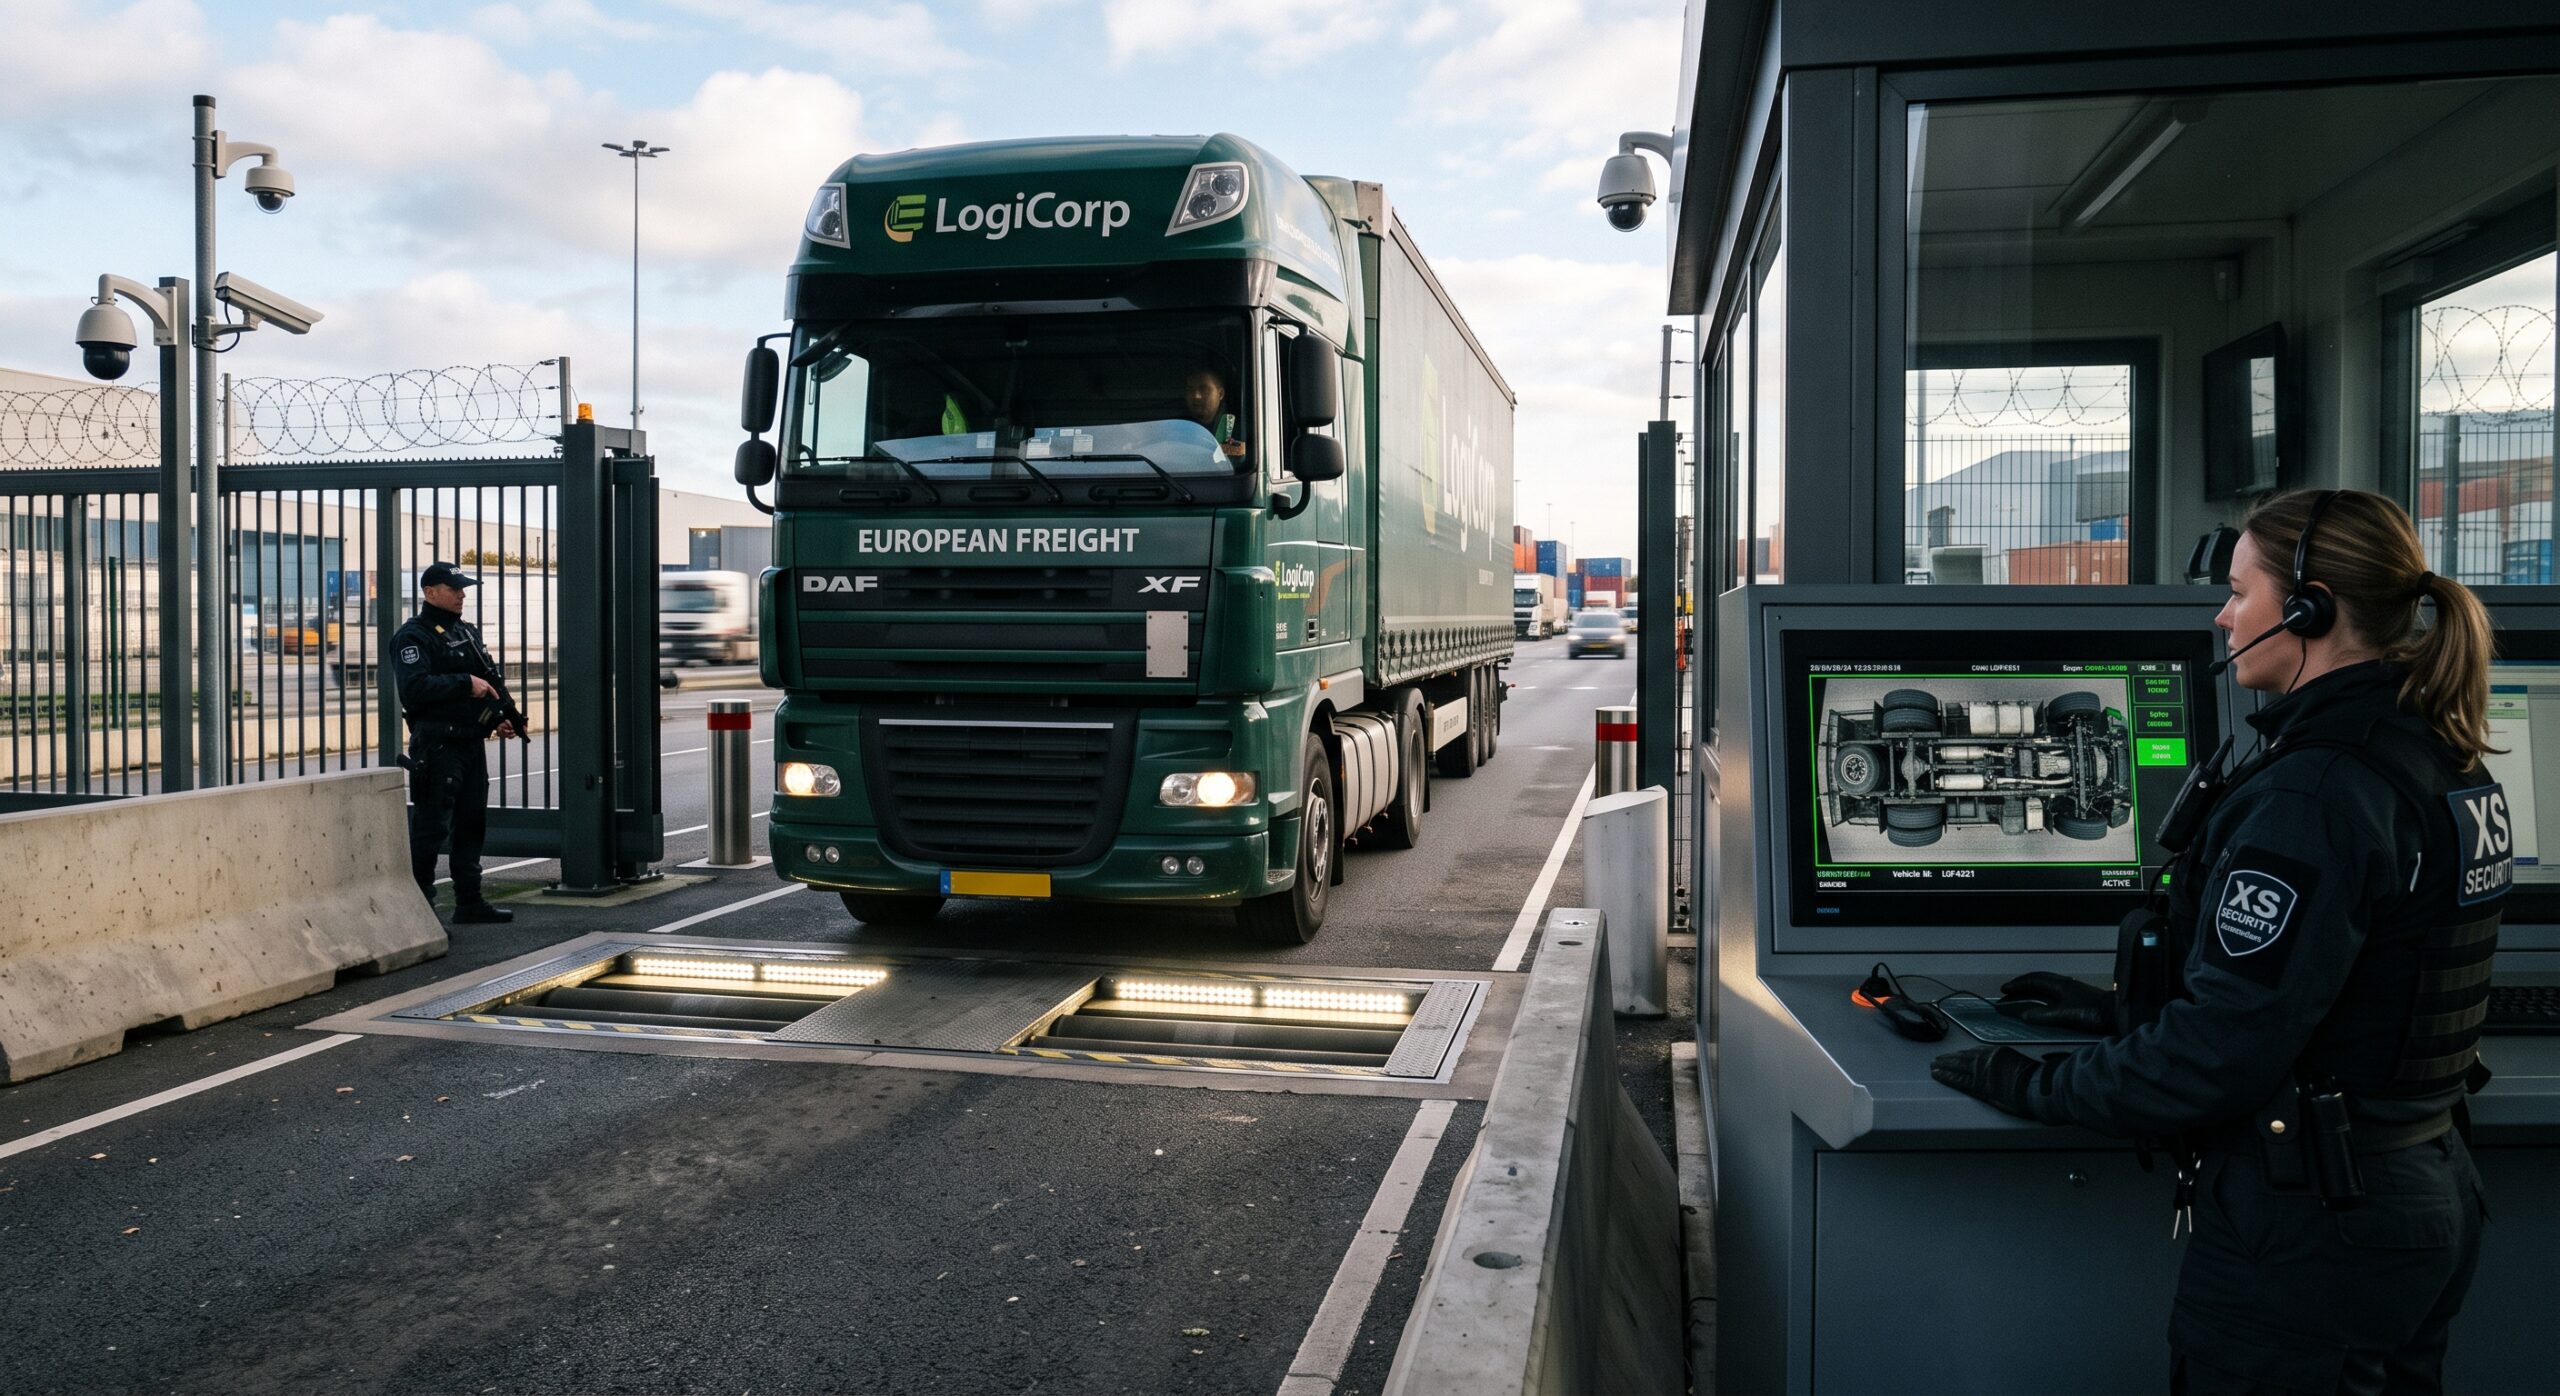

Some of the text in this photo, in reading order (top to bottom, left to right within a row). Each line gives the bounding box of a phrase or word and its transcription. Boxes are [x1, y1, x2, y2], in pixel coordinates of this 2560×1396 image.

[936, 191, 1131, 240] LogiCorp
[1442, 395, 1496, 561] LogiCorp
[858, 528, 1140, 553] EUROPEAN FREIGHT
[803, 576, 878, 592] DAF
[1137, 576, 1201, 593] XF
[2464, 792, 2510, 860] XS
[1892, 870, 1921, 878] Vehicle
[2228, 880, 2281, 919] XS
[2221, 907, 2277, 935] SECURITY
